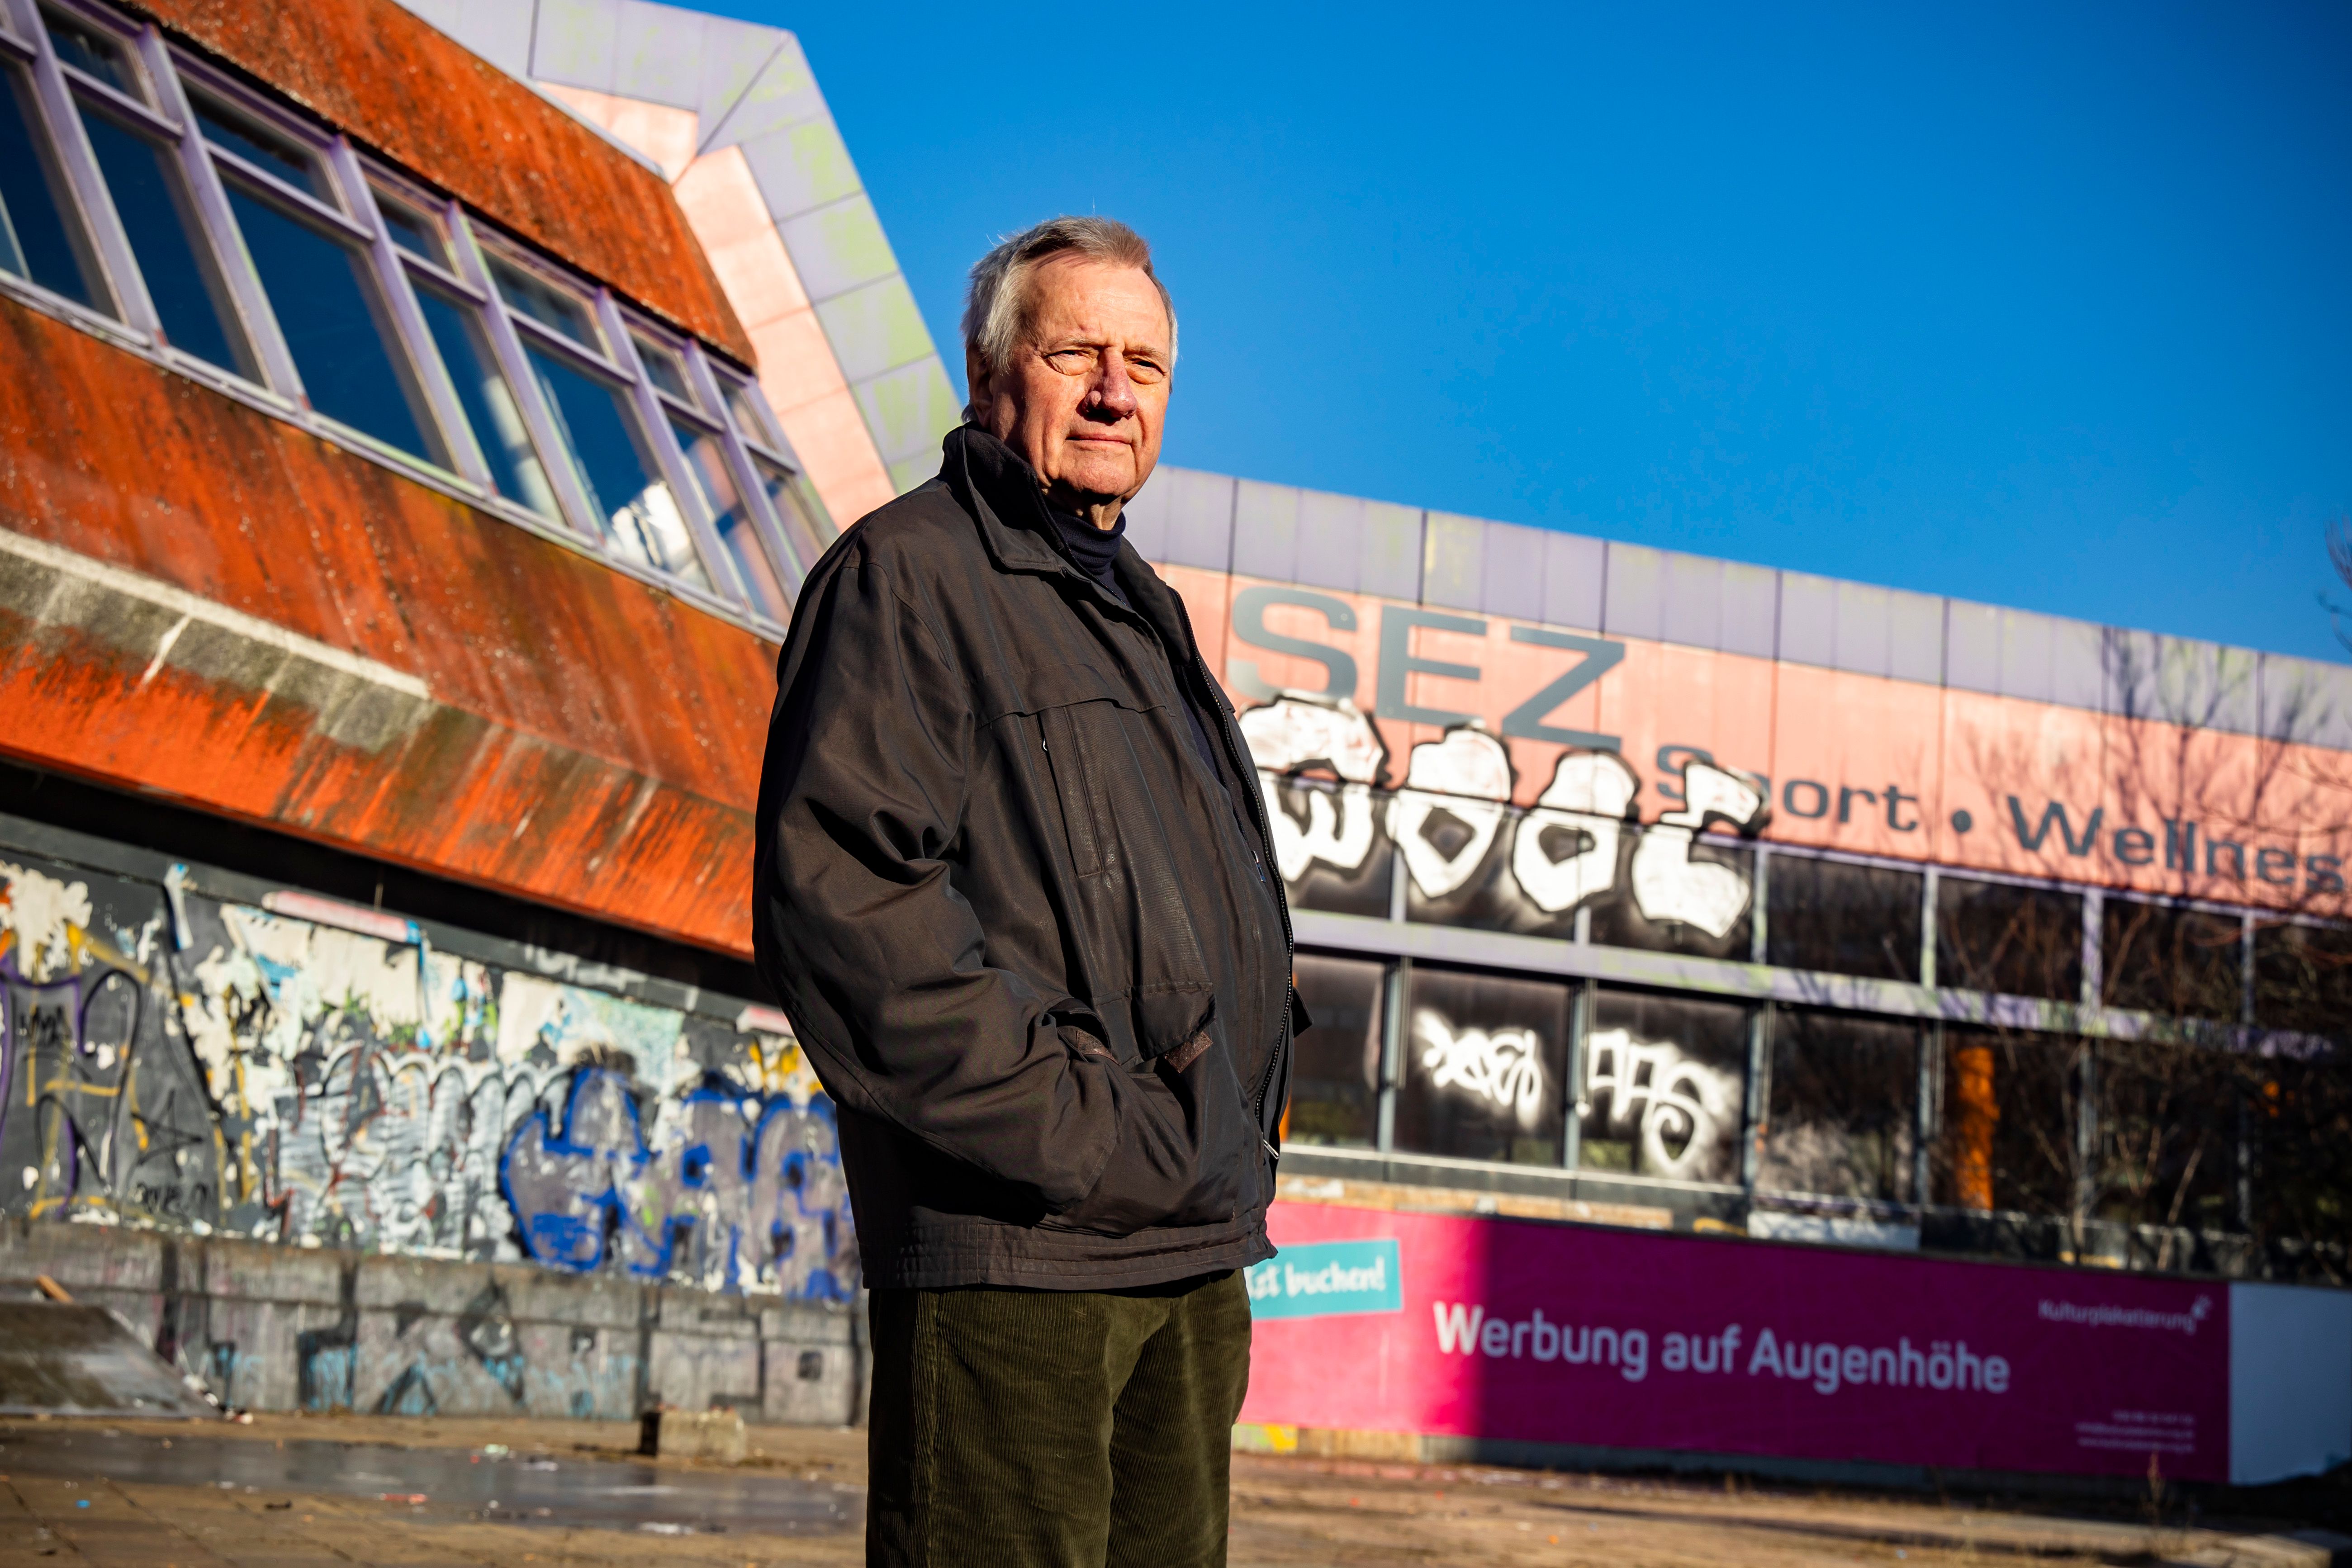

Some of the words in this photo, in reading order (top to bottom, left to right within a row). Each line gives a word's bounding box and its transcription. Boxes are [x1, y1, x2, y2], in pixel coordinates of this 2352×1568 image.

[1227, 587, 1626, 752] SEZ
[1656, 744, 1919, 832] Sort
[1284, 1255, 1387, 1298] buchen!
[1432, 1300, 1649, 1382] Werbung
[1660, 1323, 1742, 1374] auf
[1748, 1327, 2011, 1395] Augenhöhe
